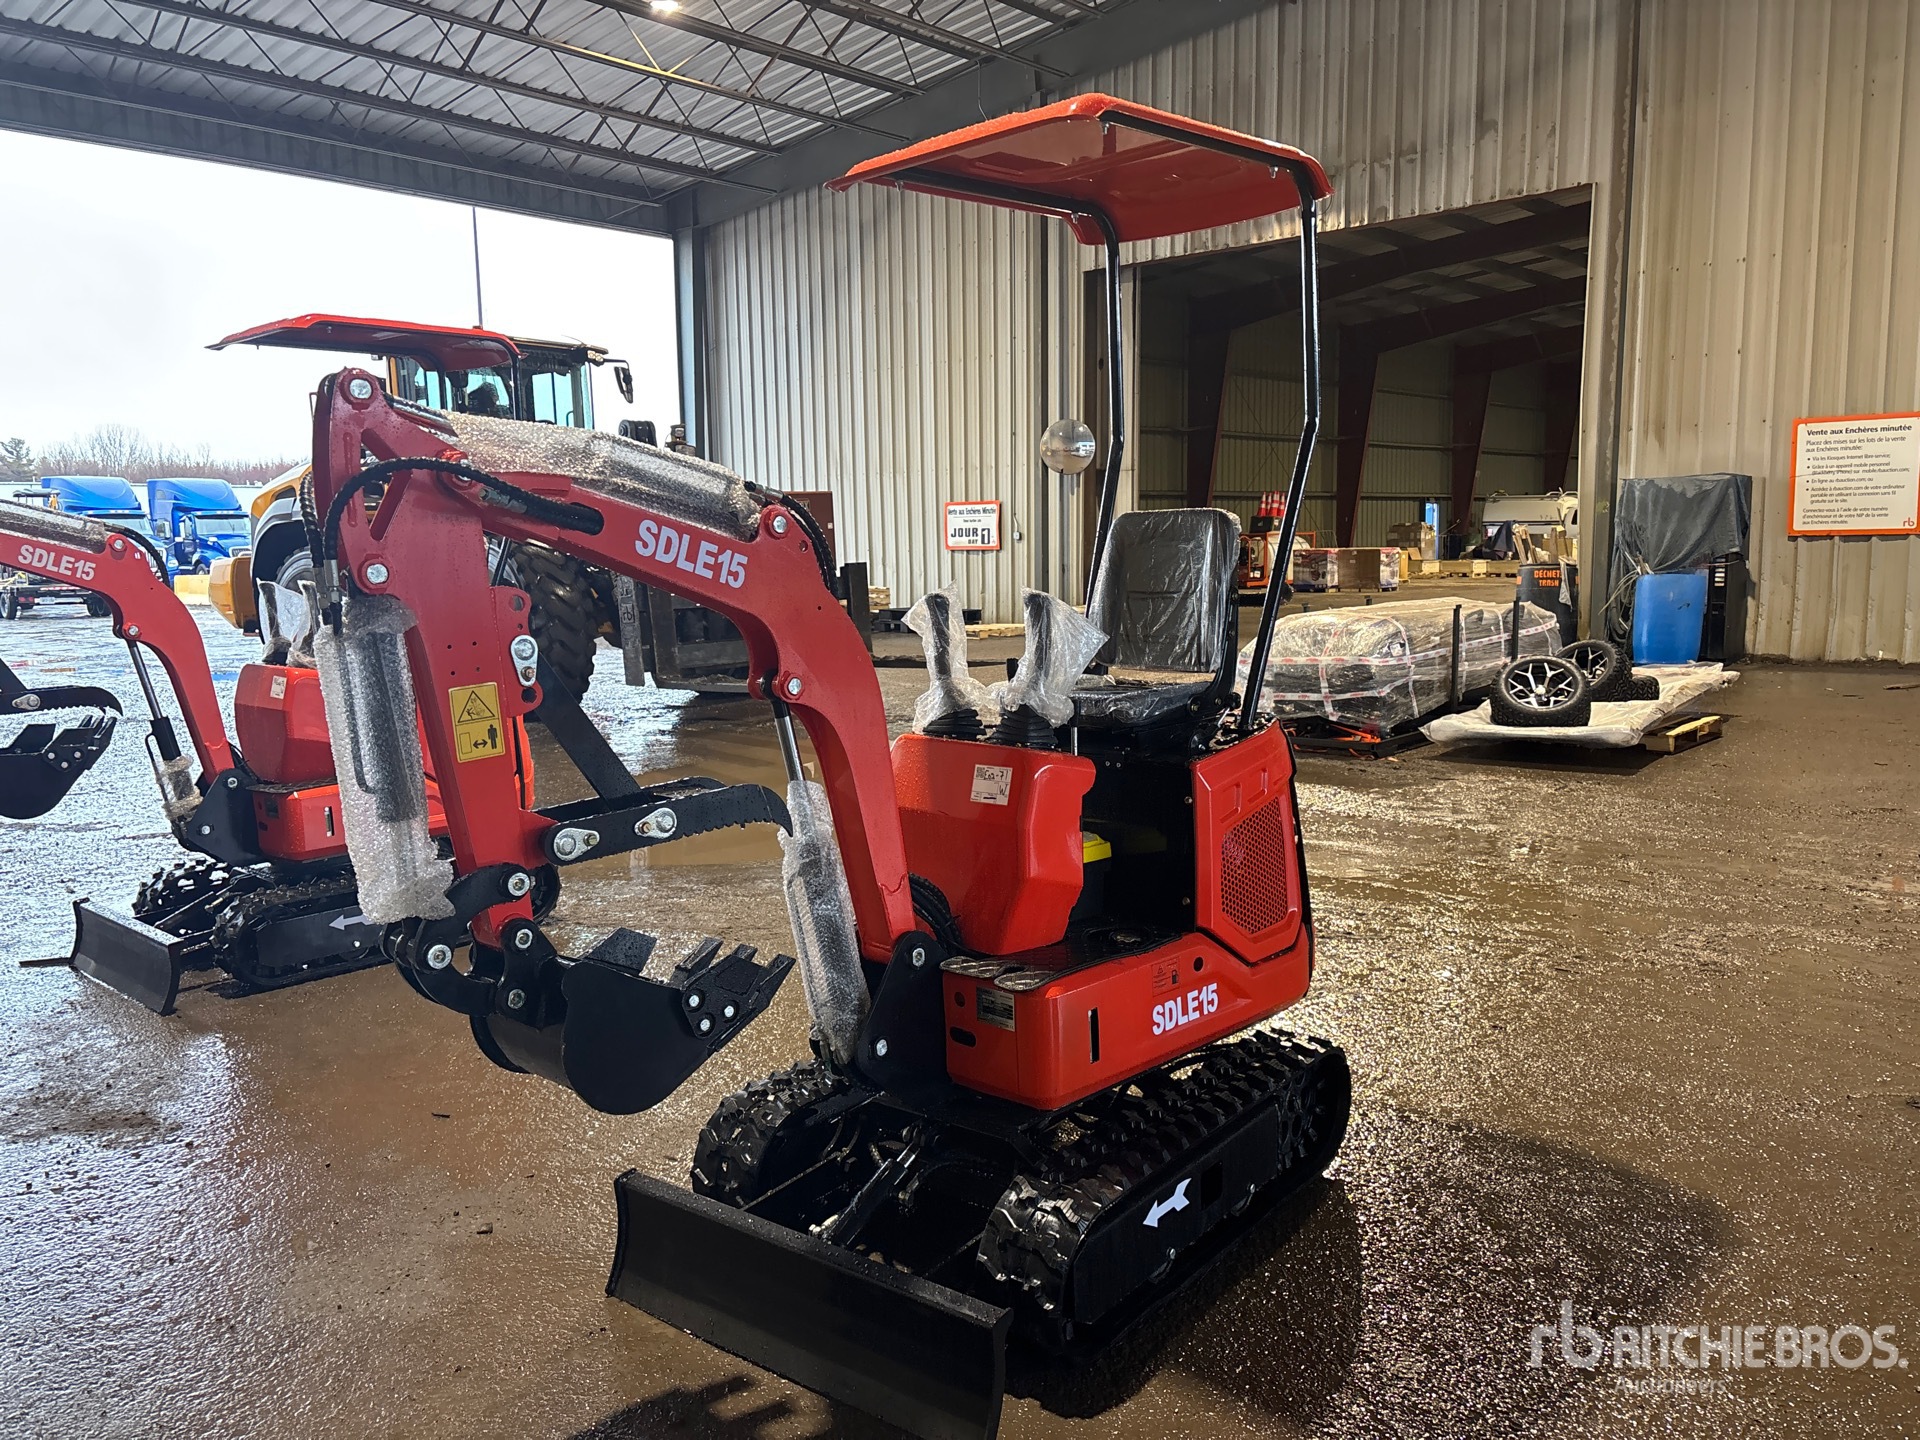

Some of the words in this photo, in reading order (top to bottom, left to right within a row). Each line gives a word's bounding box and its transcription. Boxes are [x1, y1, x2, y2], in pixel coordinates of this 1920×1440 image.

[1845, 426, 1879, 434] Enchères
[1880, 424, 1912, 432] minutée
[1903, 517, 1915, 527] rb
[951, 528, 979, 538] JOUR
[981, 528, 990, 545] 1
[17, 544, 97, 581] SDLE15
[635, 519, 749, 589] SDLE15
[1152, 982, 1219, 1036] SDLE15
